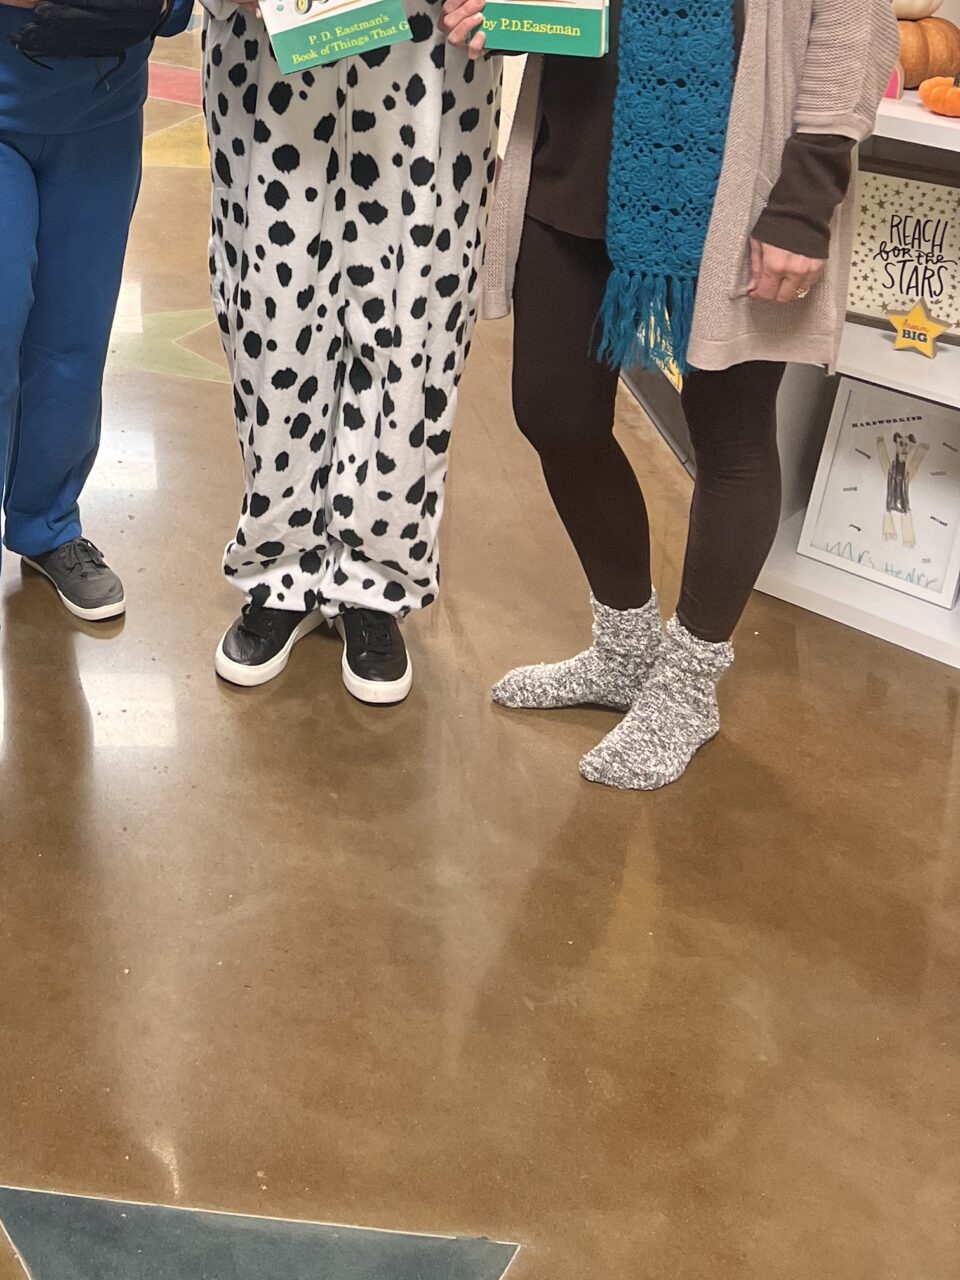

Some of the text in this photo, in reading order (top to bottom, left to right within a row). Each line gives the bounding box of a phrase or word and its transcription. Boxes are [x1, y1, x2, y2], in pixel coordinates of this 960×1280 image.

[307, 13, 390, 46] P. D. Eastman's
[482, 16, 498, 31] by
[291, 21, 409, 65] Book of Things That G
[890, 214, 949, 254] REACH
[914, 249, 959, 266] the
[881, 259, 949, 299] STARS
[902, 329, 928, 343] BIG
